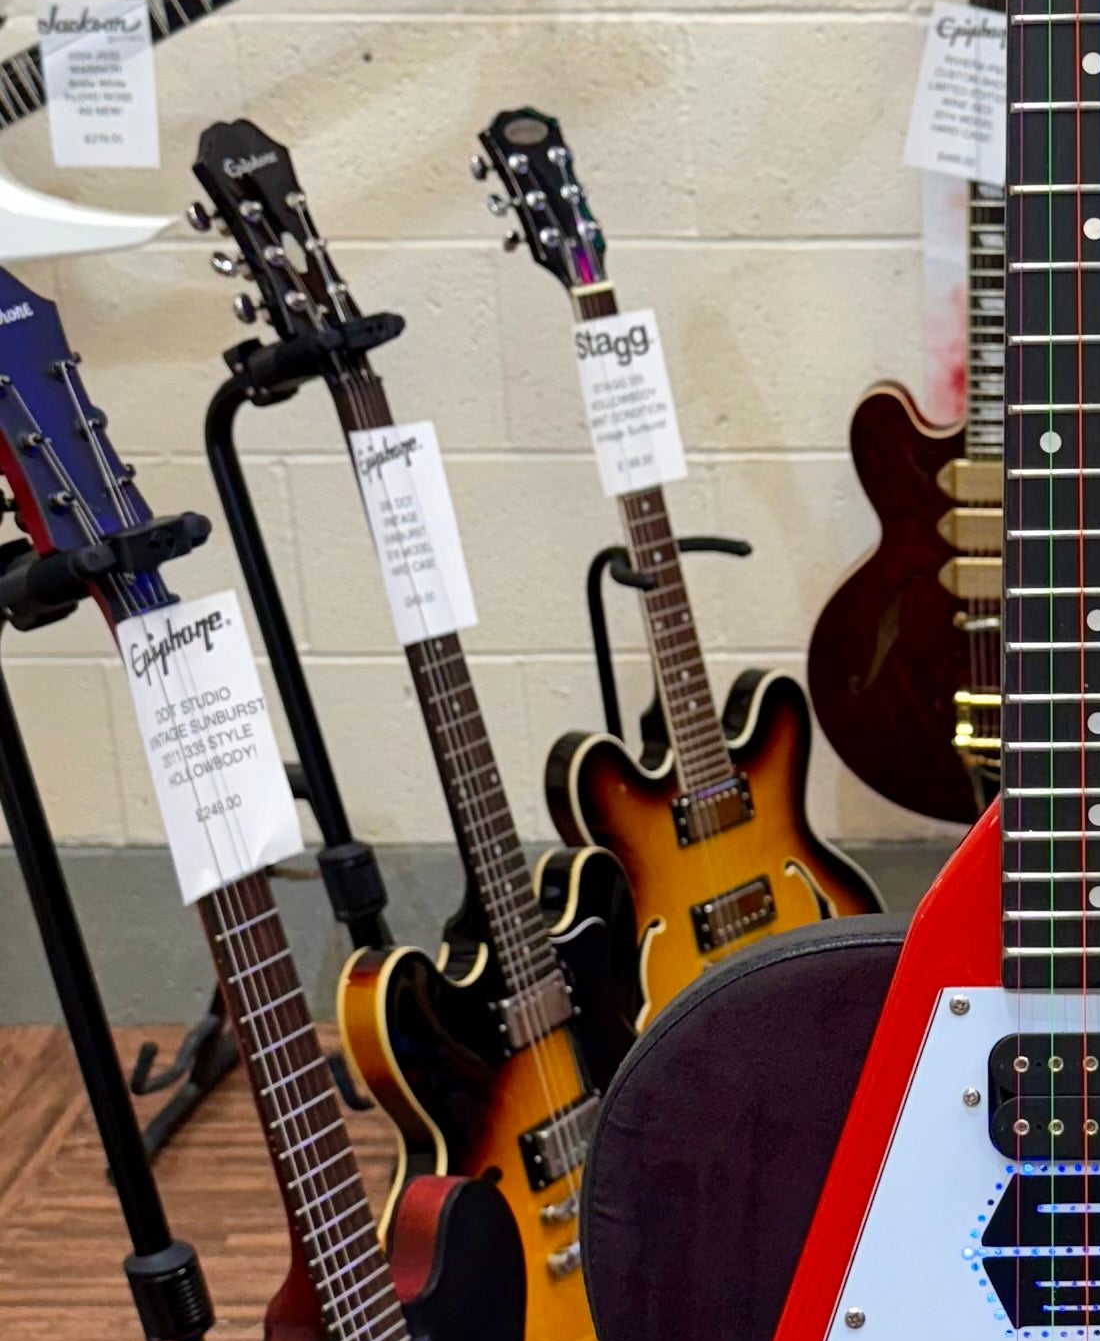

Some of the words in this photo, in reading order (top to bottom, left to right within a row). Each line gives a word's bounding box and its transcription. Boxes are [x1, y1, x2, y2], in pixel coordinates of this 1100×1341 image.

[180, 686, 231, 715] STUDIO
[190, 697, 265, 735] SUNBURST
[208, 723, 254, 751] STYLE
